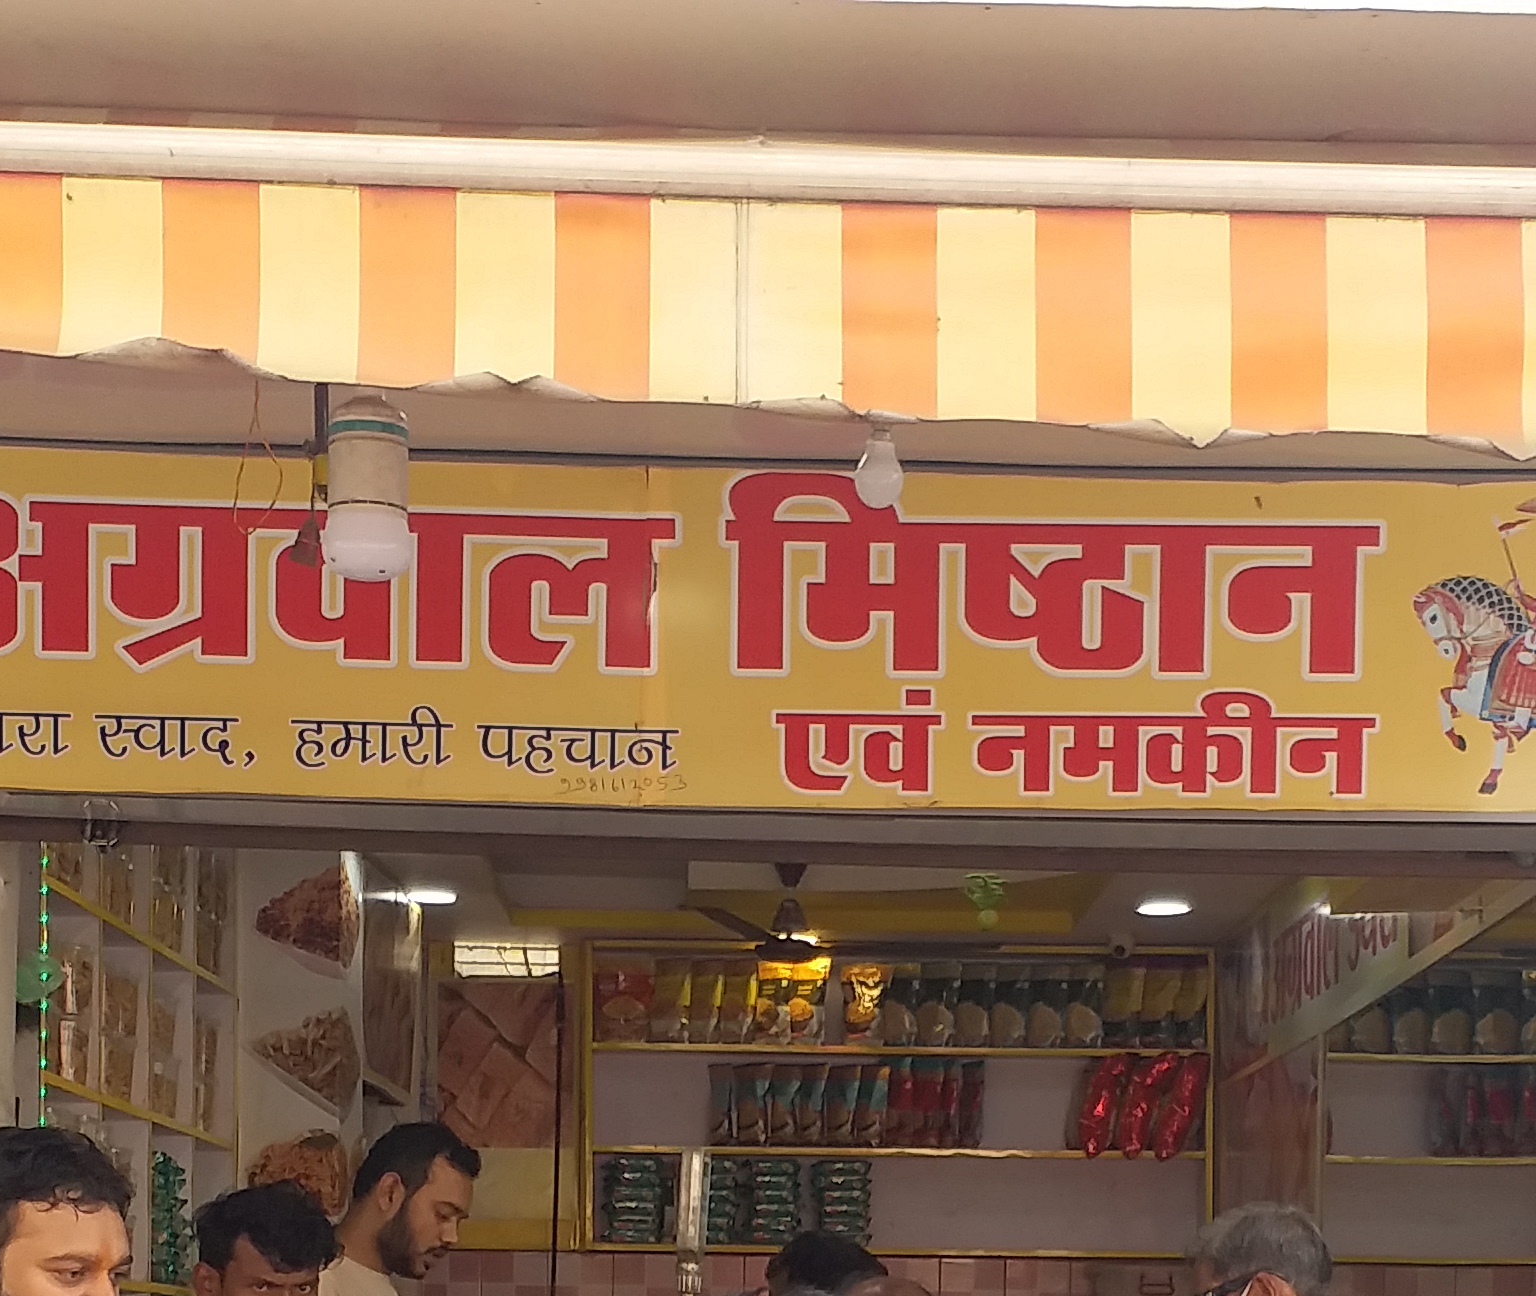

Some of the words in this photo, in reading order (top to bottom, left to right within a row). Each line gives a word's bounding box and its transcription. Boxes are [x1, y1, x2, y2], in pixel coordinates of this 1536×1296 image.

[95, 713, 257, 770] स्वाद,
[290, 704, 454, 769] हमारी
[477, 722, 680, 776] पहचान
[774, 687, 944, 794] एवं
[970, 691, 1378, 797] नमकीन
